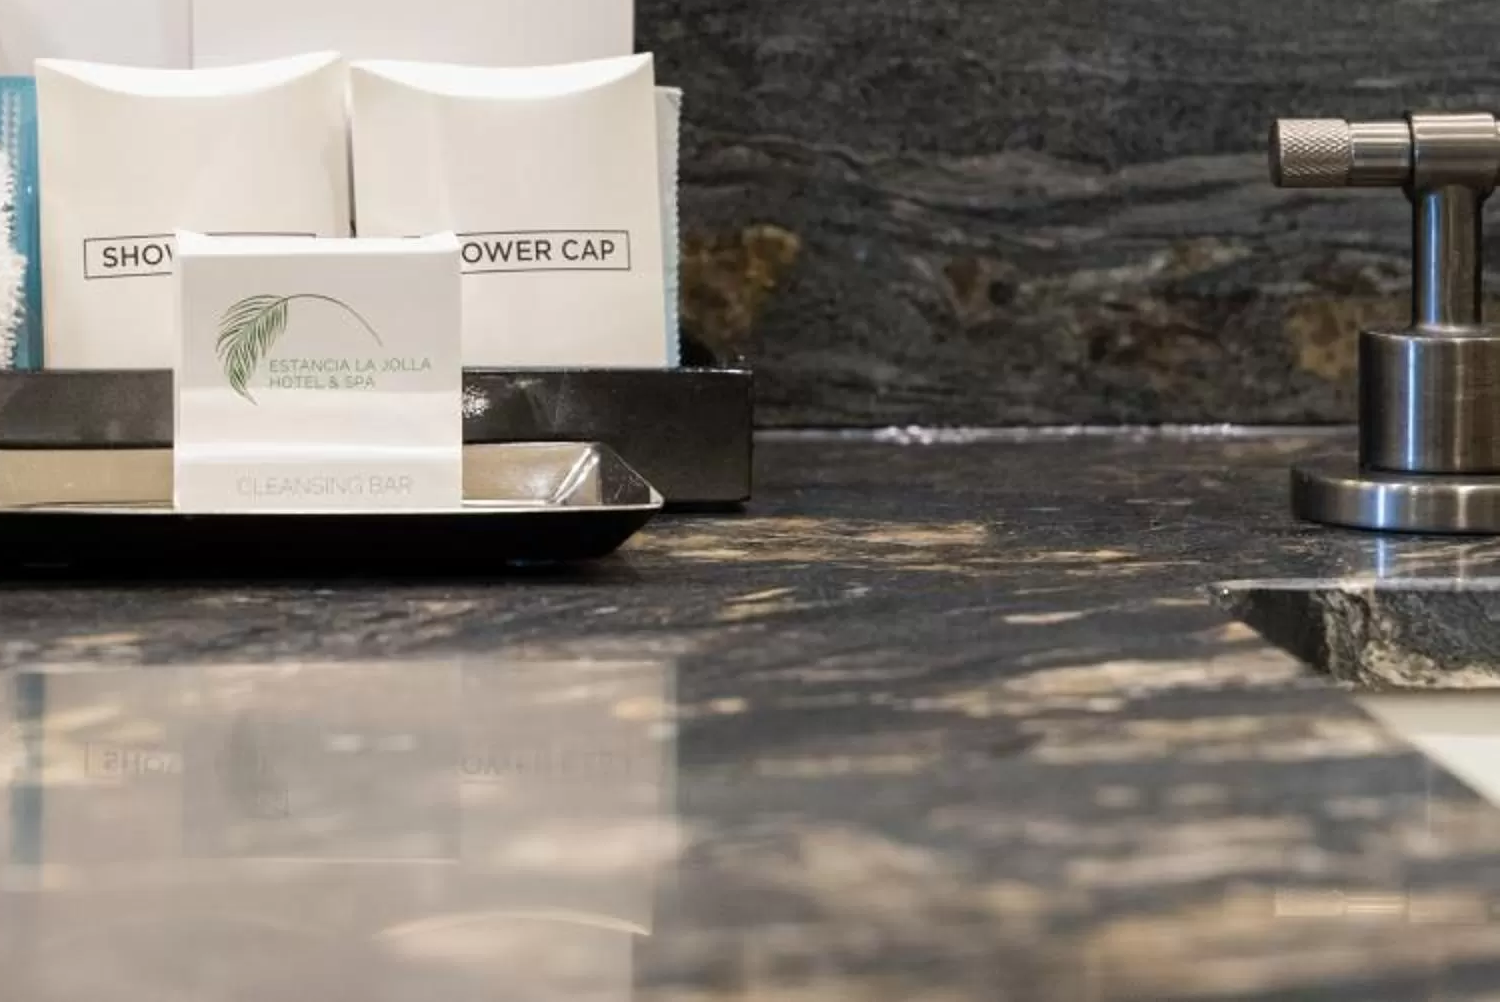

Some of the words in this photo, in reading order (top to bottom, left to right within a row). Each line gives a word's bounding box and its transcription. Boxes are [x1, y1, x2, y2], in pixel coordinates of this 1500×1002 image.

[561, 238, 615, 261] CAP
[269, 358, 350, 373] ESTANCIA
[355, 358, 377, 372] LA
[380, 357, 432, 372] JOLLA
[269, 375, 325, 390] HOTEL
[328, 375, 340, 389] &
[345, 375, 376, 389] SPA
[236, 475, 365, 496] CLEANSING
[368, 474, 415, 496] BAR
